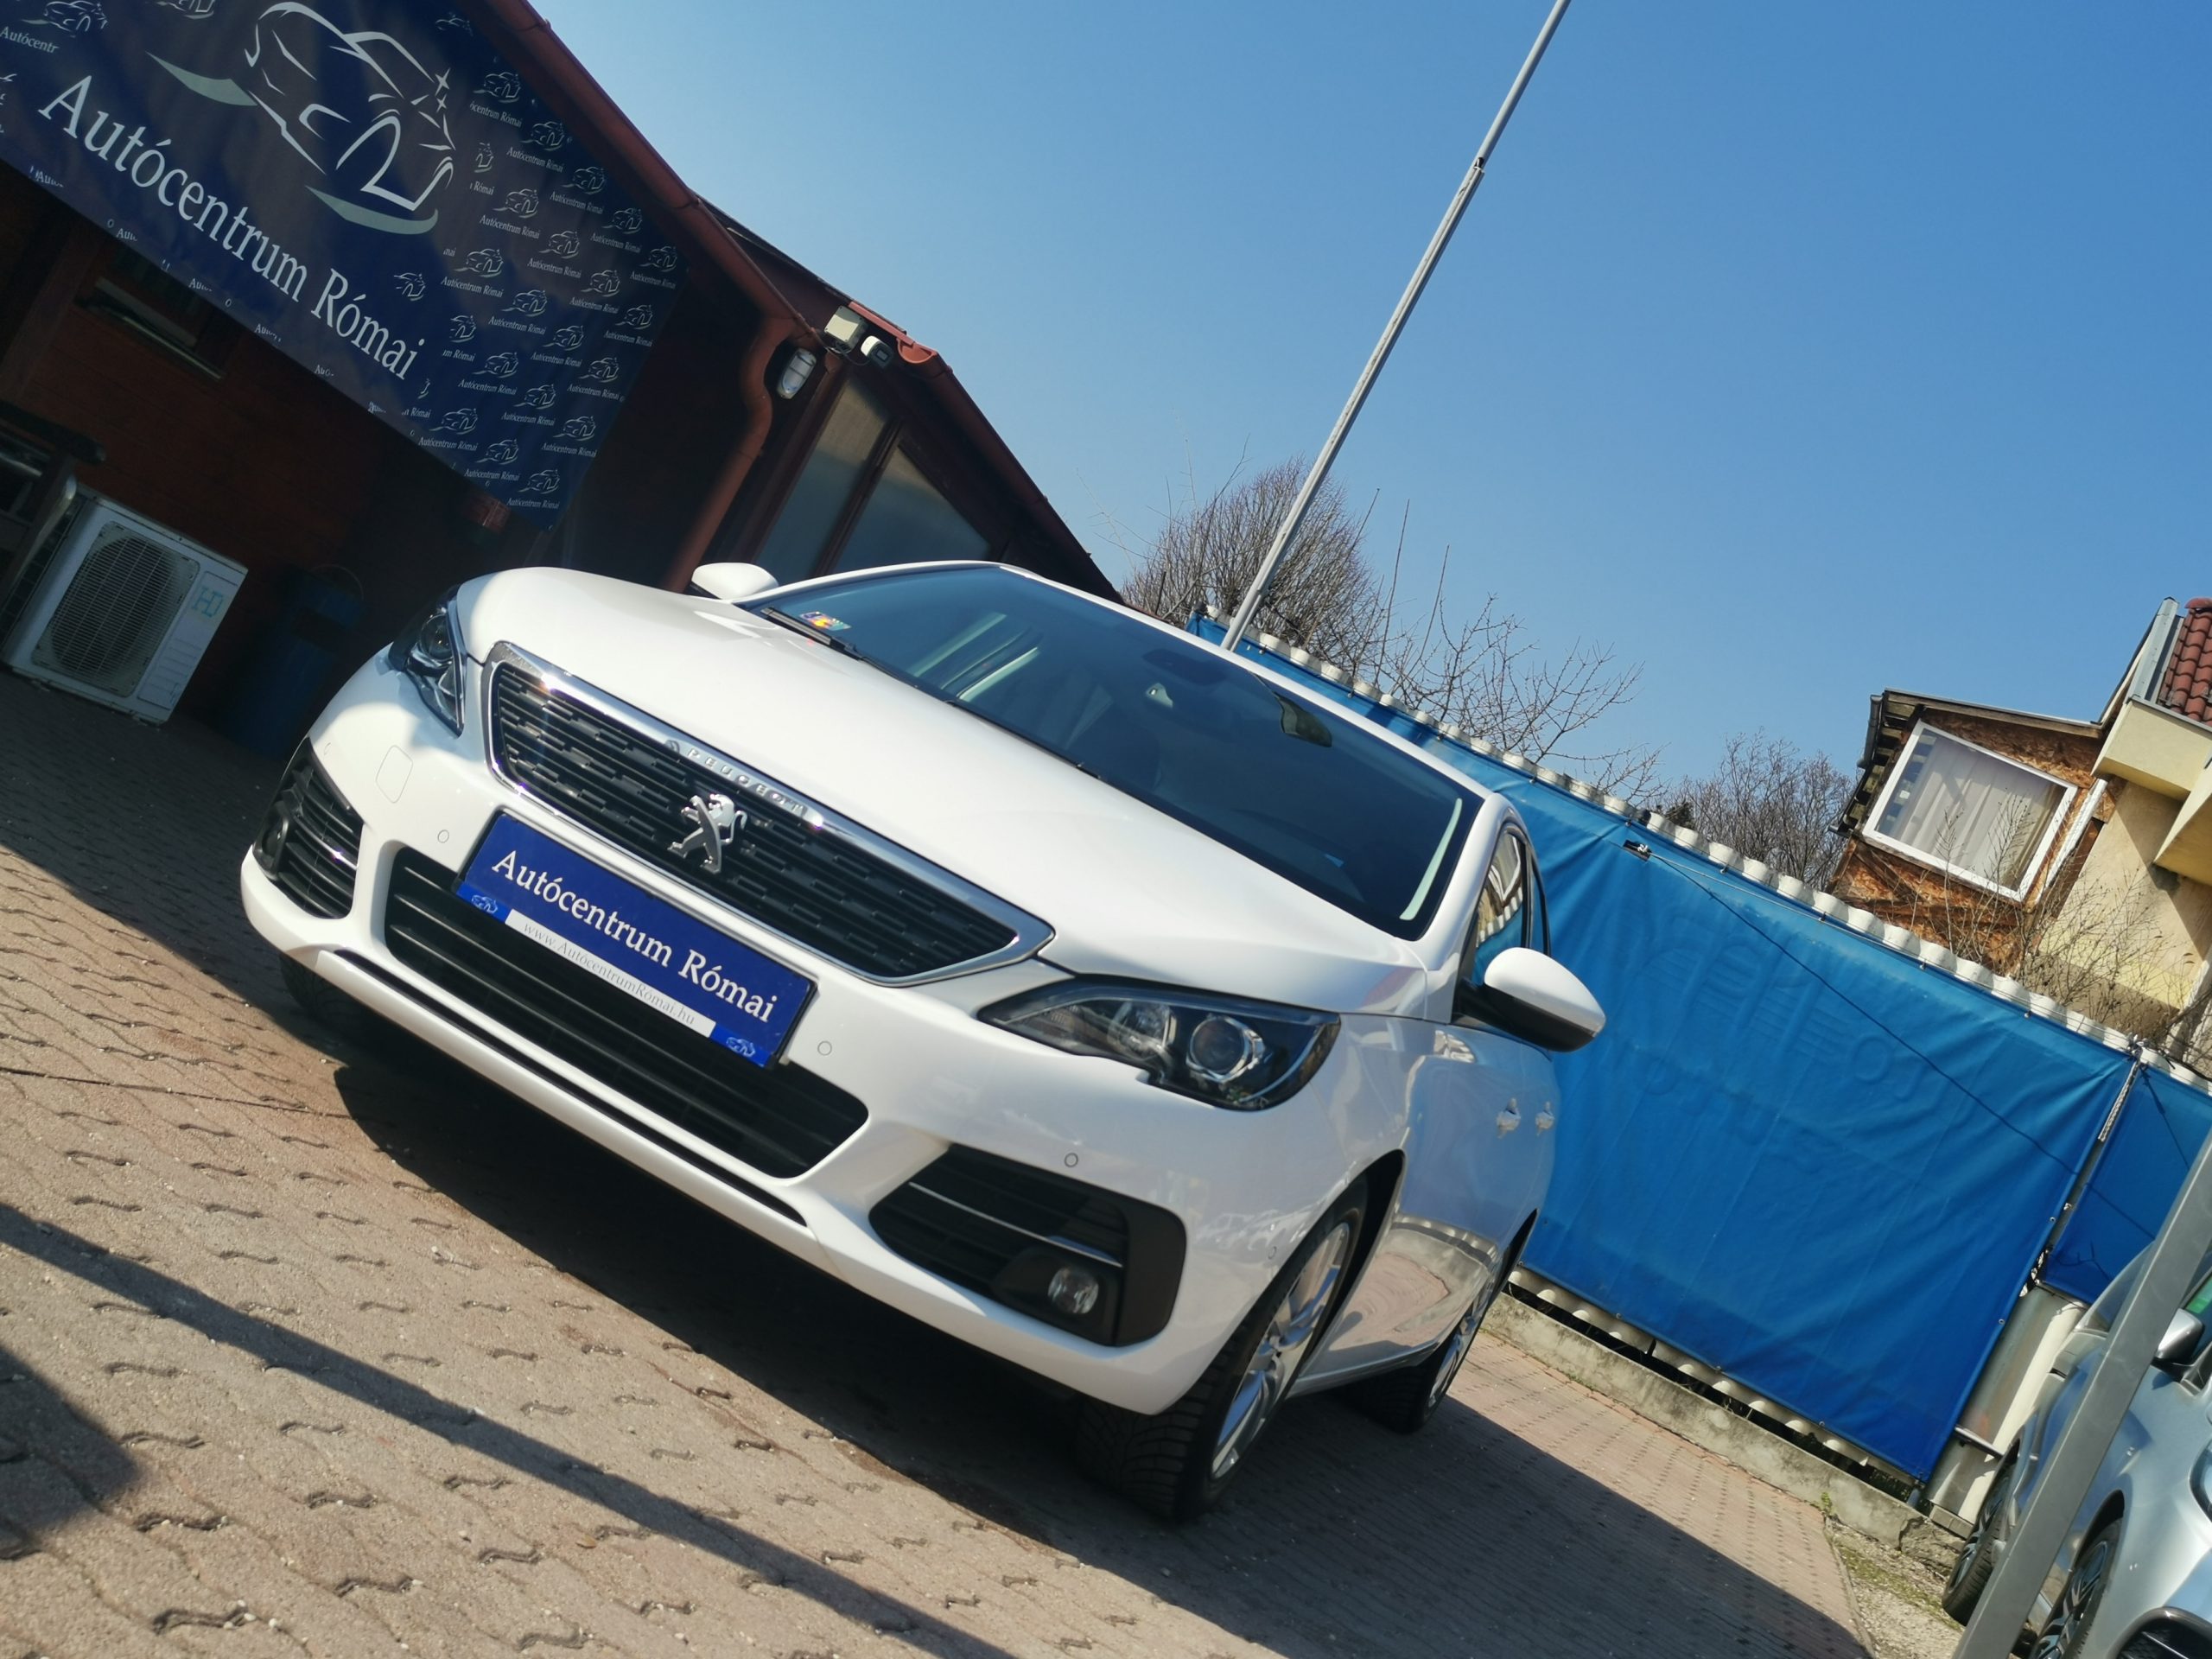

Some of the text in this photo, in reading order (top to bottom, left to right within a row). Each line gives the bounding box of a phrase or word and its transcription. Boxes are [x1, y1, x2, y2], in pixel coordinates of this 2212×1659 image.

[38, 75, 425, 380] Autócentrum Római
[479, 214, 540, 239] Autócentrum Római
[527, 257, 563, 275] Autócentrum
[441, 276, 504, 298] Autócentrum Római
[488, 316, 527, 332] Autócentrum
[454, 349, 475, 362] Római
[410, 408, 431, 418] Római
[492, 850, 779, 1023] Autócentrum Római
